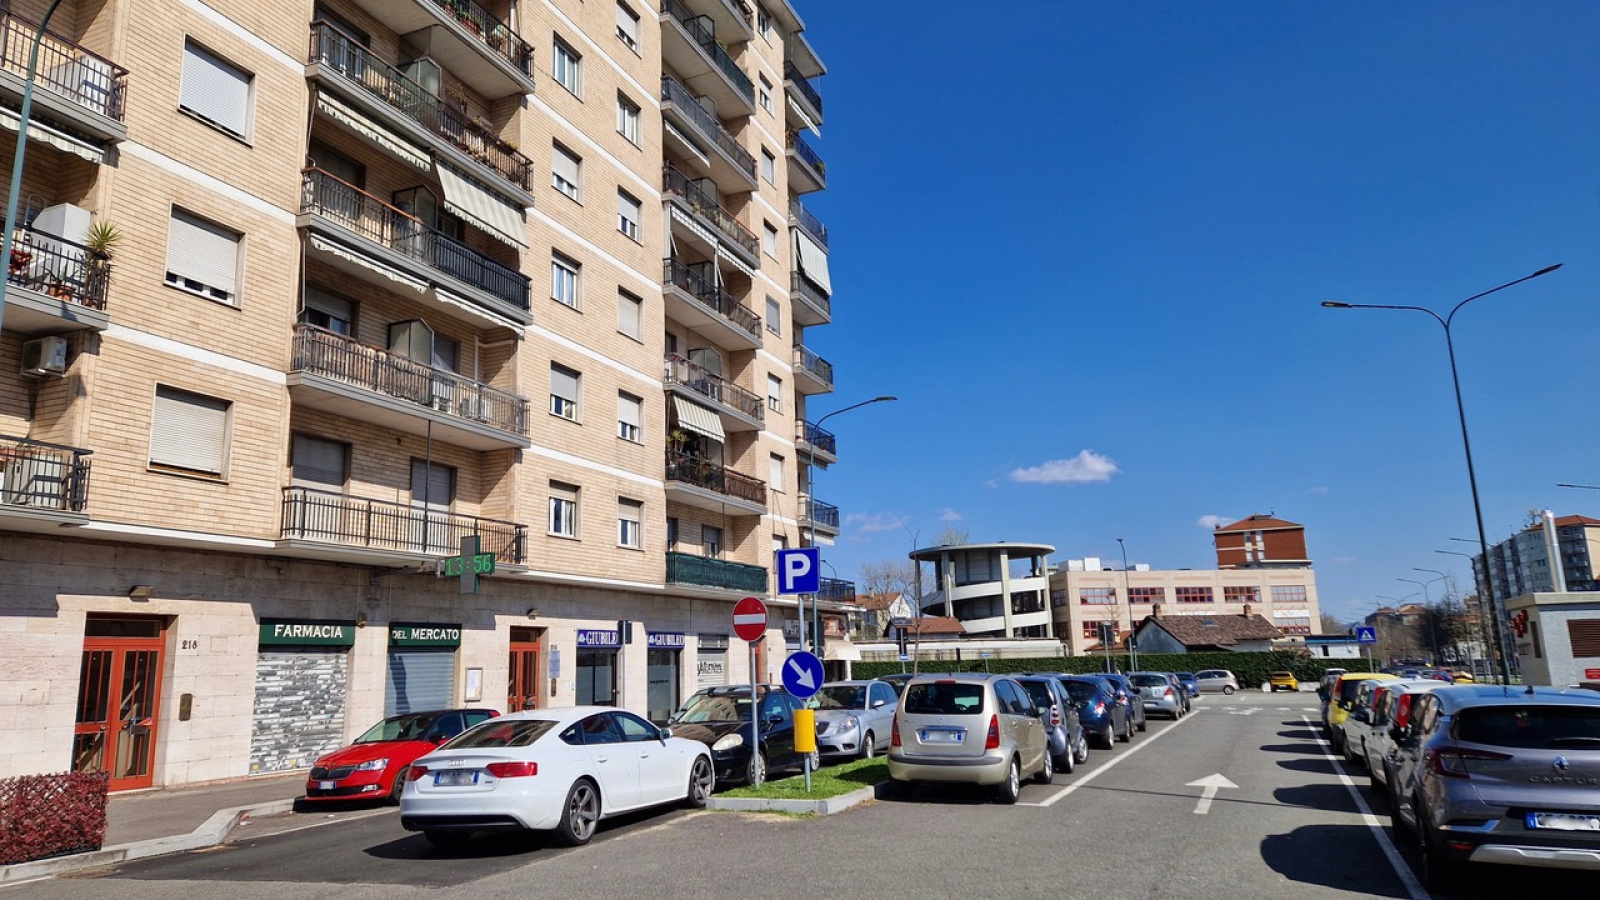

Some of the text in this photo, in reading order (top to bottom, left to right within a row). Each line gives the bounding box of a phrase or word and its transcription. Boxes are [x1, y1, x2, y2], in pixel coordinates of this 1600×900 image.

[445, 555, 491, 575] 13:56
[785, 553, 811, 590] P
[274, 624, 343, 638] FARMACIA
[392, 629, 460, 640] DEL MERCATO
[654, 634, 685, 646] GIUBILEO
[1529, 775, 1597, 786] CAPTUR
